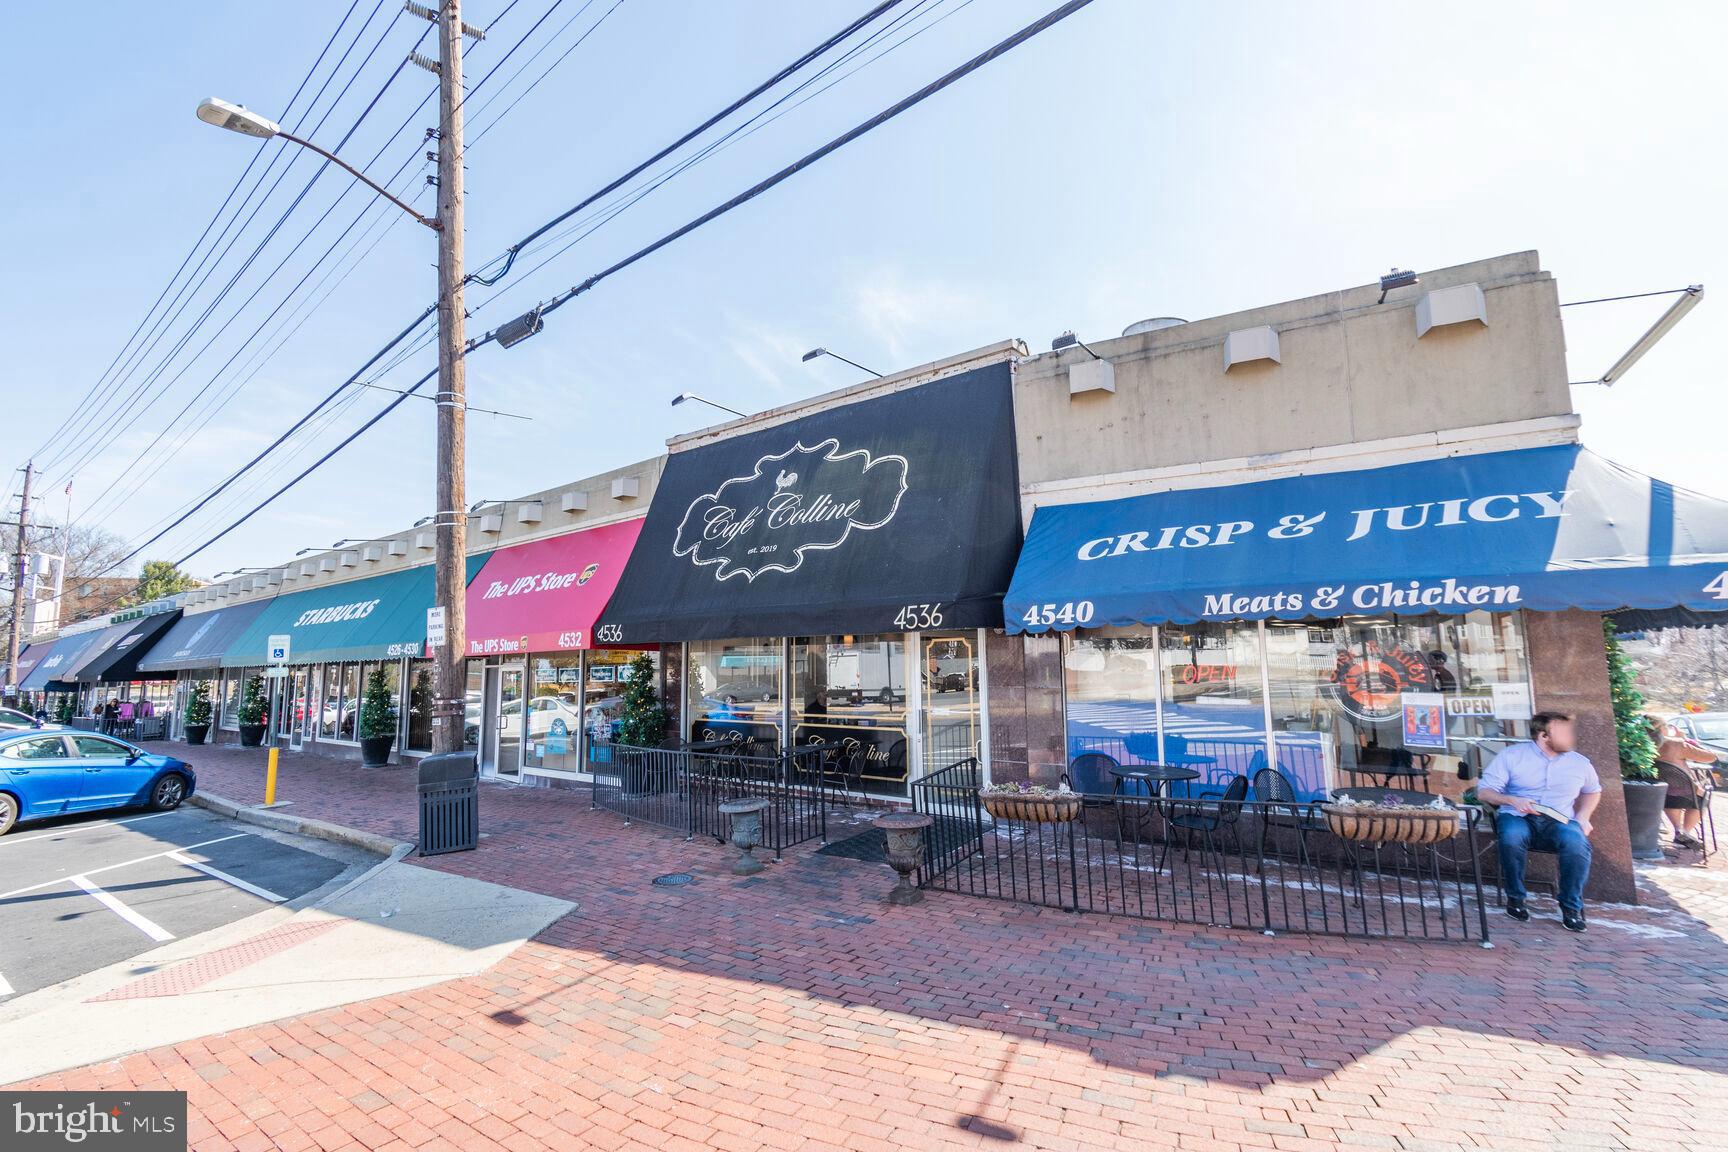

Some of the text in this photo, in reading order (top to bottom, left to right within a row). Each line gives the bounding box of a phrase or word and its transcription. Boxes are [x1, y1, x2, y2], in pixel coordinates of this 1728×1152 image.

[703, 493, 861, 550] Café Colline
[1077, 489, 1580, 561] CRISP & JUICY
[760, 544, 778, 553] 2019
[482, 581, 508, 600] The
[508, 574, 540, 597] UPS
[536, 571, 577, 592] Store
[1202, 578, 1523, 617] Meats & Chicken
[293, 598, 381, 628] STARBUCKS
[893, 602, 943, 630] 4536
[1022, 600, 1095, 626] 4540
[470, 638, 519, 654] The UPS Store
[558, 631, 582, 648] 4532
[597, 624, 623, 642] 4536
[1182, 664, 1237, 685] OPEN
[1451, 699, 1492, 714] OPEN
